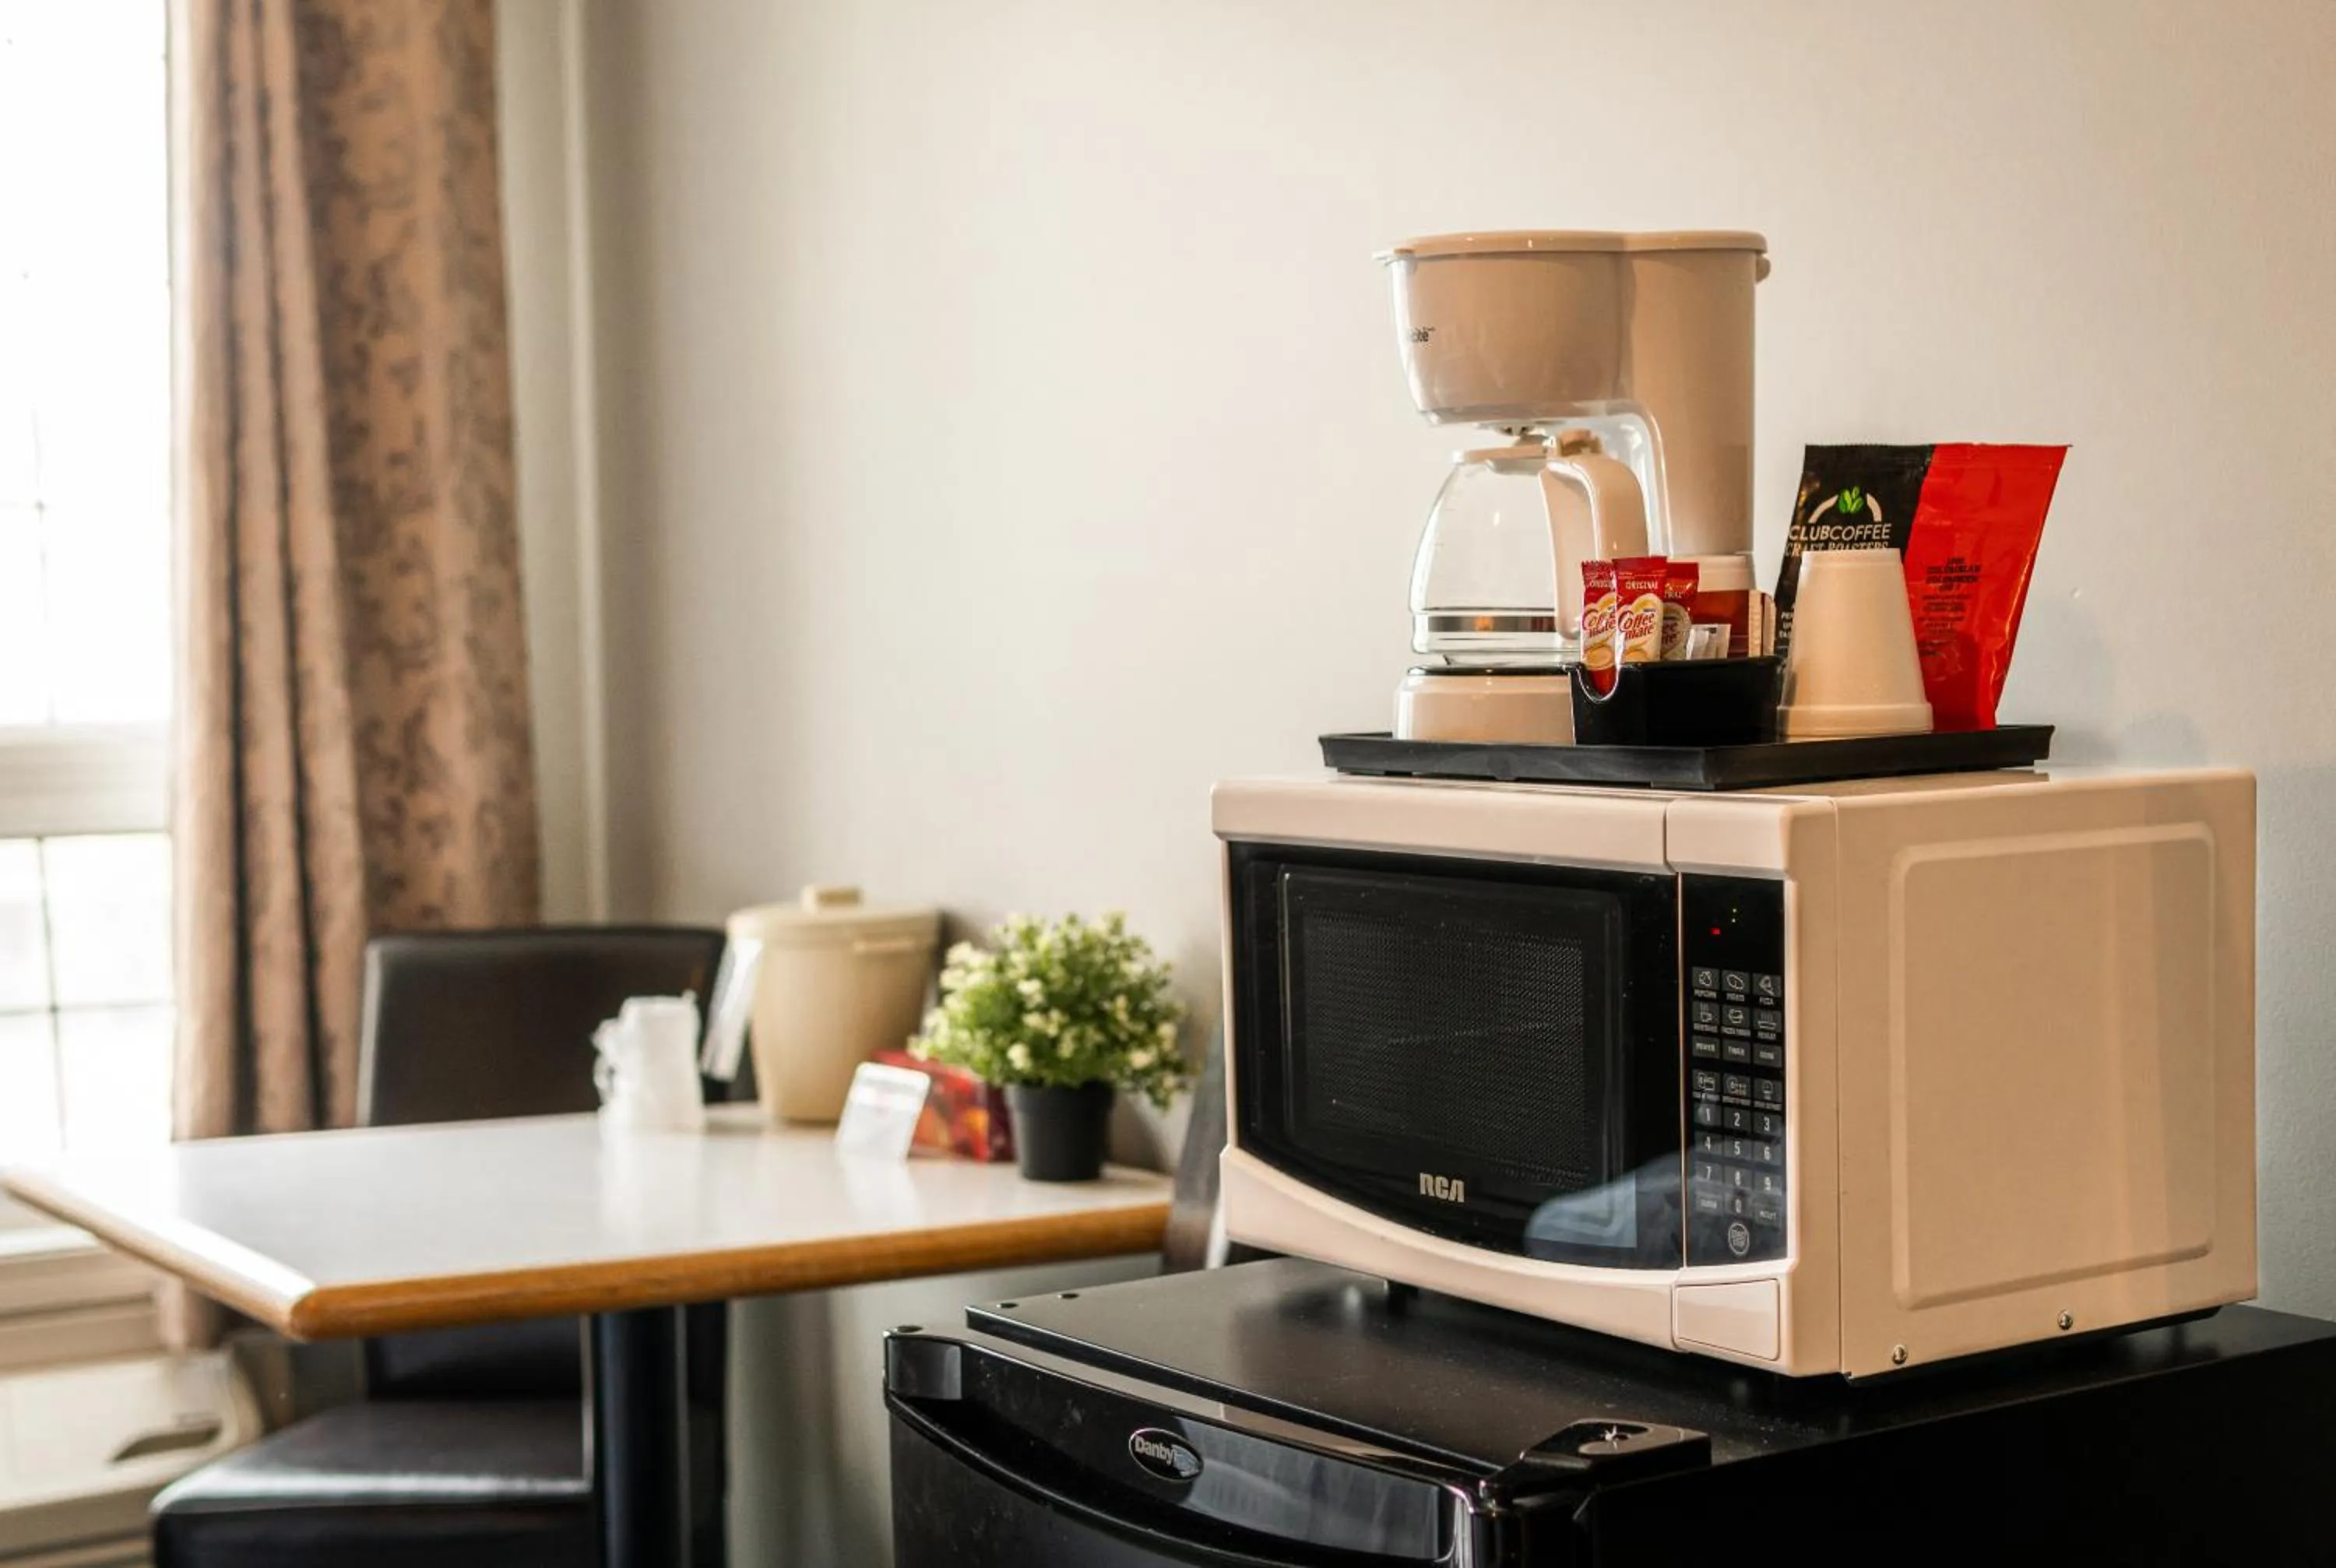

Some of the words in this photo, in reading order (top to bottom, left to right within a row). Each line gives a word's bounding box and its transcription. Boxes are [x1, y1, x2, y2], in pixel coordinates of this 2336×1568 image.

[1789, 523, 1891, 542] CLUBCOFFEE
[1625, 580, 1659, 590] ORIGINAL
[1618, 609, 1655, 633] Coffee
[1624, 624, 1655, 640] mate
[1706, 1108, 1711, 1122] 1
[1733, 1113, 1740, 1127] 2
[1764, 1116, 1770, 1131] 3
[1705, 1136, 1711, 1151] 4
[1733, 1141, 1740, 1155] 5
[1764, 1146, 1771, 1161] 6
[1706, 1165, 1712, 1180] 7
[1735, 1171, 1741, 1187] 8
[1419, 1172, 1465, 1203] RCA
[1764, 1176, 1771, 1190] 9
[1735, 1199, 1742, 1214] 0
[1135, 1434, 1177, 1465] Danby
